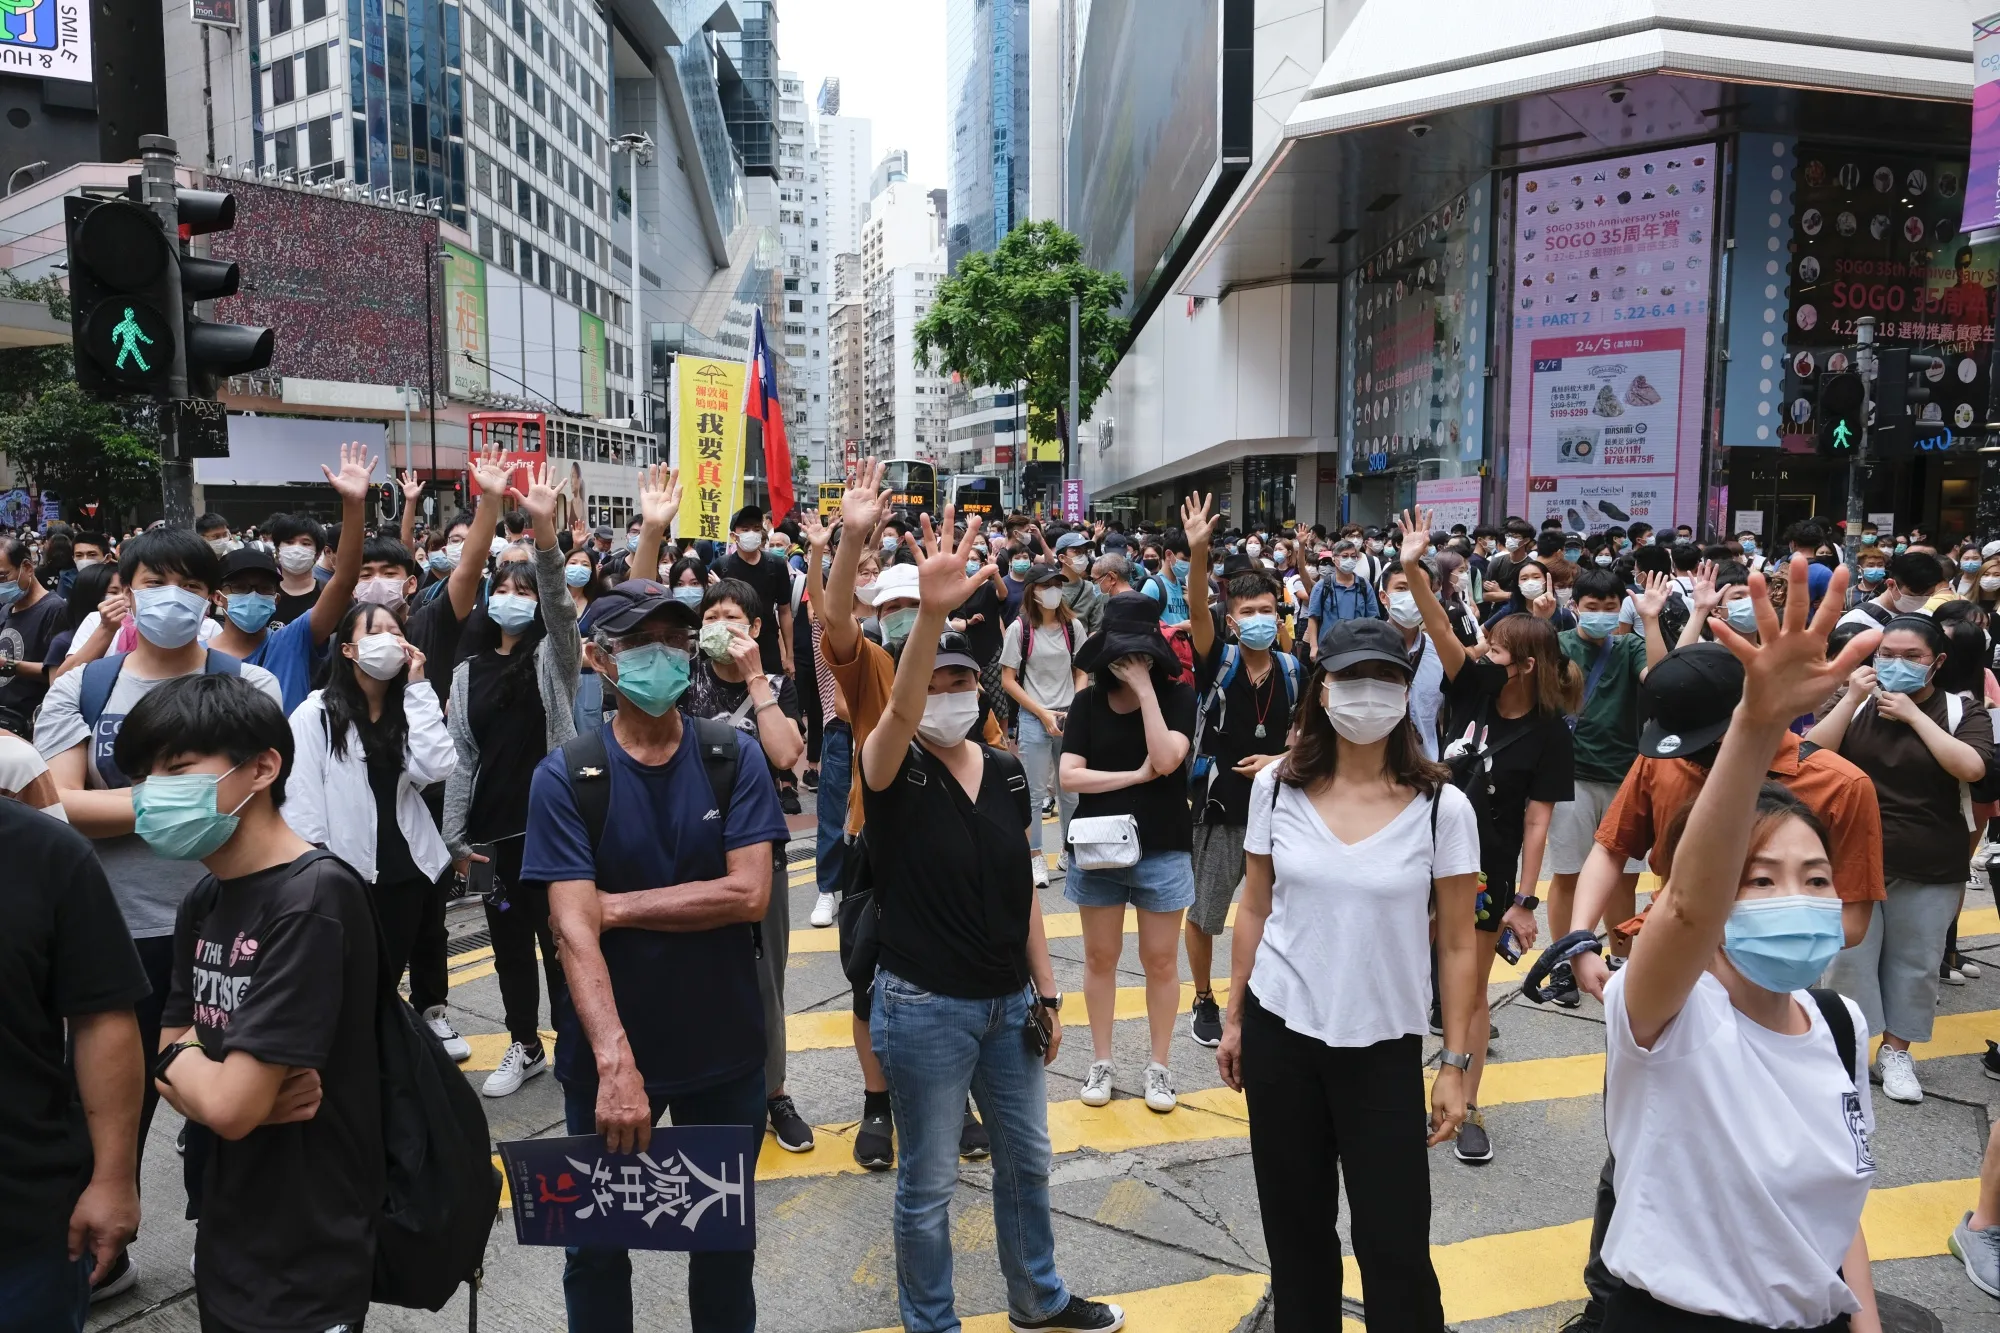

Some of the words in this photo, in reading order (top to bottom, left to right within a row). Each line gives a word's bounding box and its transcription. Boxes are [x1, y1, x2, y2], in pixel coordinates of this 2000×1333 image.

[61, 5, 78, 63] SMILE
[0, 50, 31, 66] HU
[1981, 54, 2000, 68] CO
[1545, 223, 1573, 234] SOGO
[1574, 220, 1596, 230] 35th
[1598, 213, 1657, 227] Anniversary
[1659, 209, 1681, 219] Sale
[1545, 231, 1596, 251] SOGO
[1600, 219, 1680, 244] 35周年賞
[1834, 258, 1874, 274] SOGO
[1877, 262, 1905, 276] 35th
[1832, 281, 1905, 312] SOGO
[455, 290, 479, 351] 租
[1542, 312, 1579, 327] PART
[1582, 311, 1591, 324] 2
[1613, 303, 1676, 321] 5.22-6.4
[1575, 337, 1611, 353] 24/5
[1538, 360, 1558, 370] 2/F
[1550, 408, 1588, 418] $199-$299
[1368, 453, 1387, 471] SOGO
[1534, 481, 1553, 490] 6/F
[1579, 486, 1600, 495] Josef
[1600, 485, 1624, 494] Seibel
[1629, 507, 1649, 516] $698
[202, 941, 223, 965] THE
[565, 1148, 746, 1233] 天滅中共
